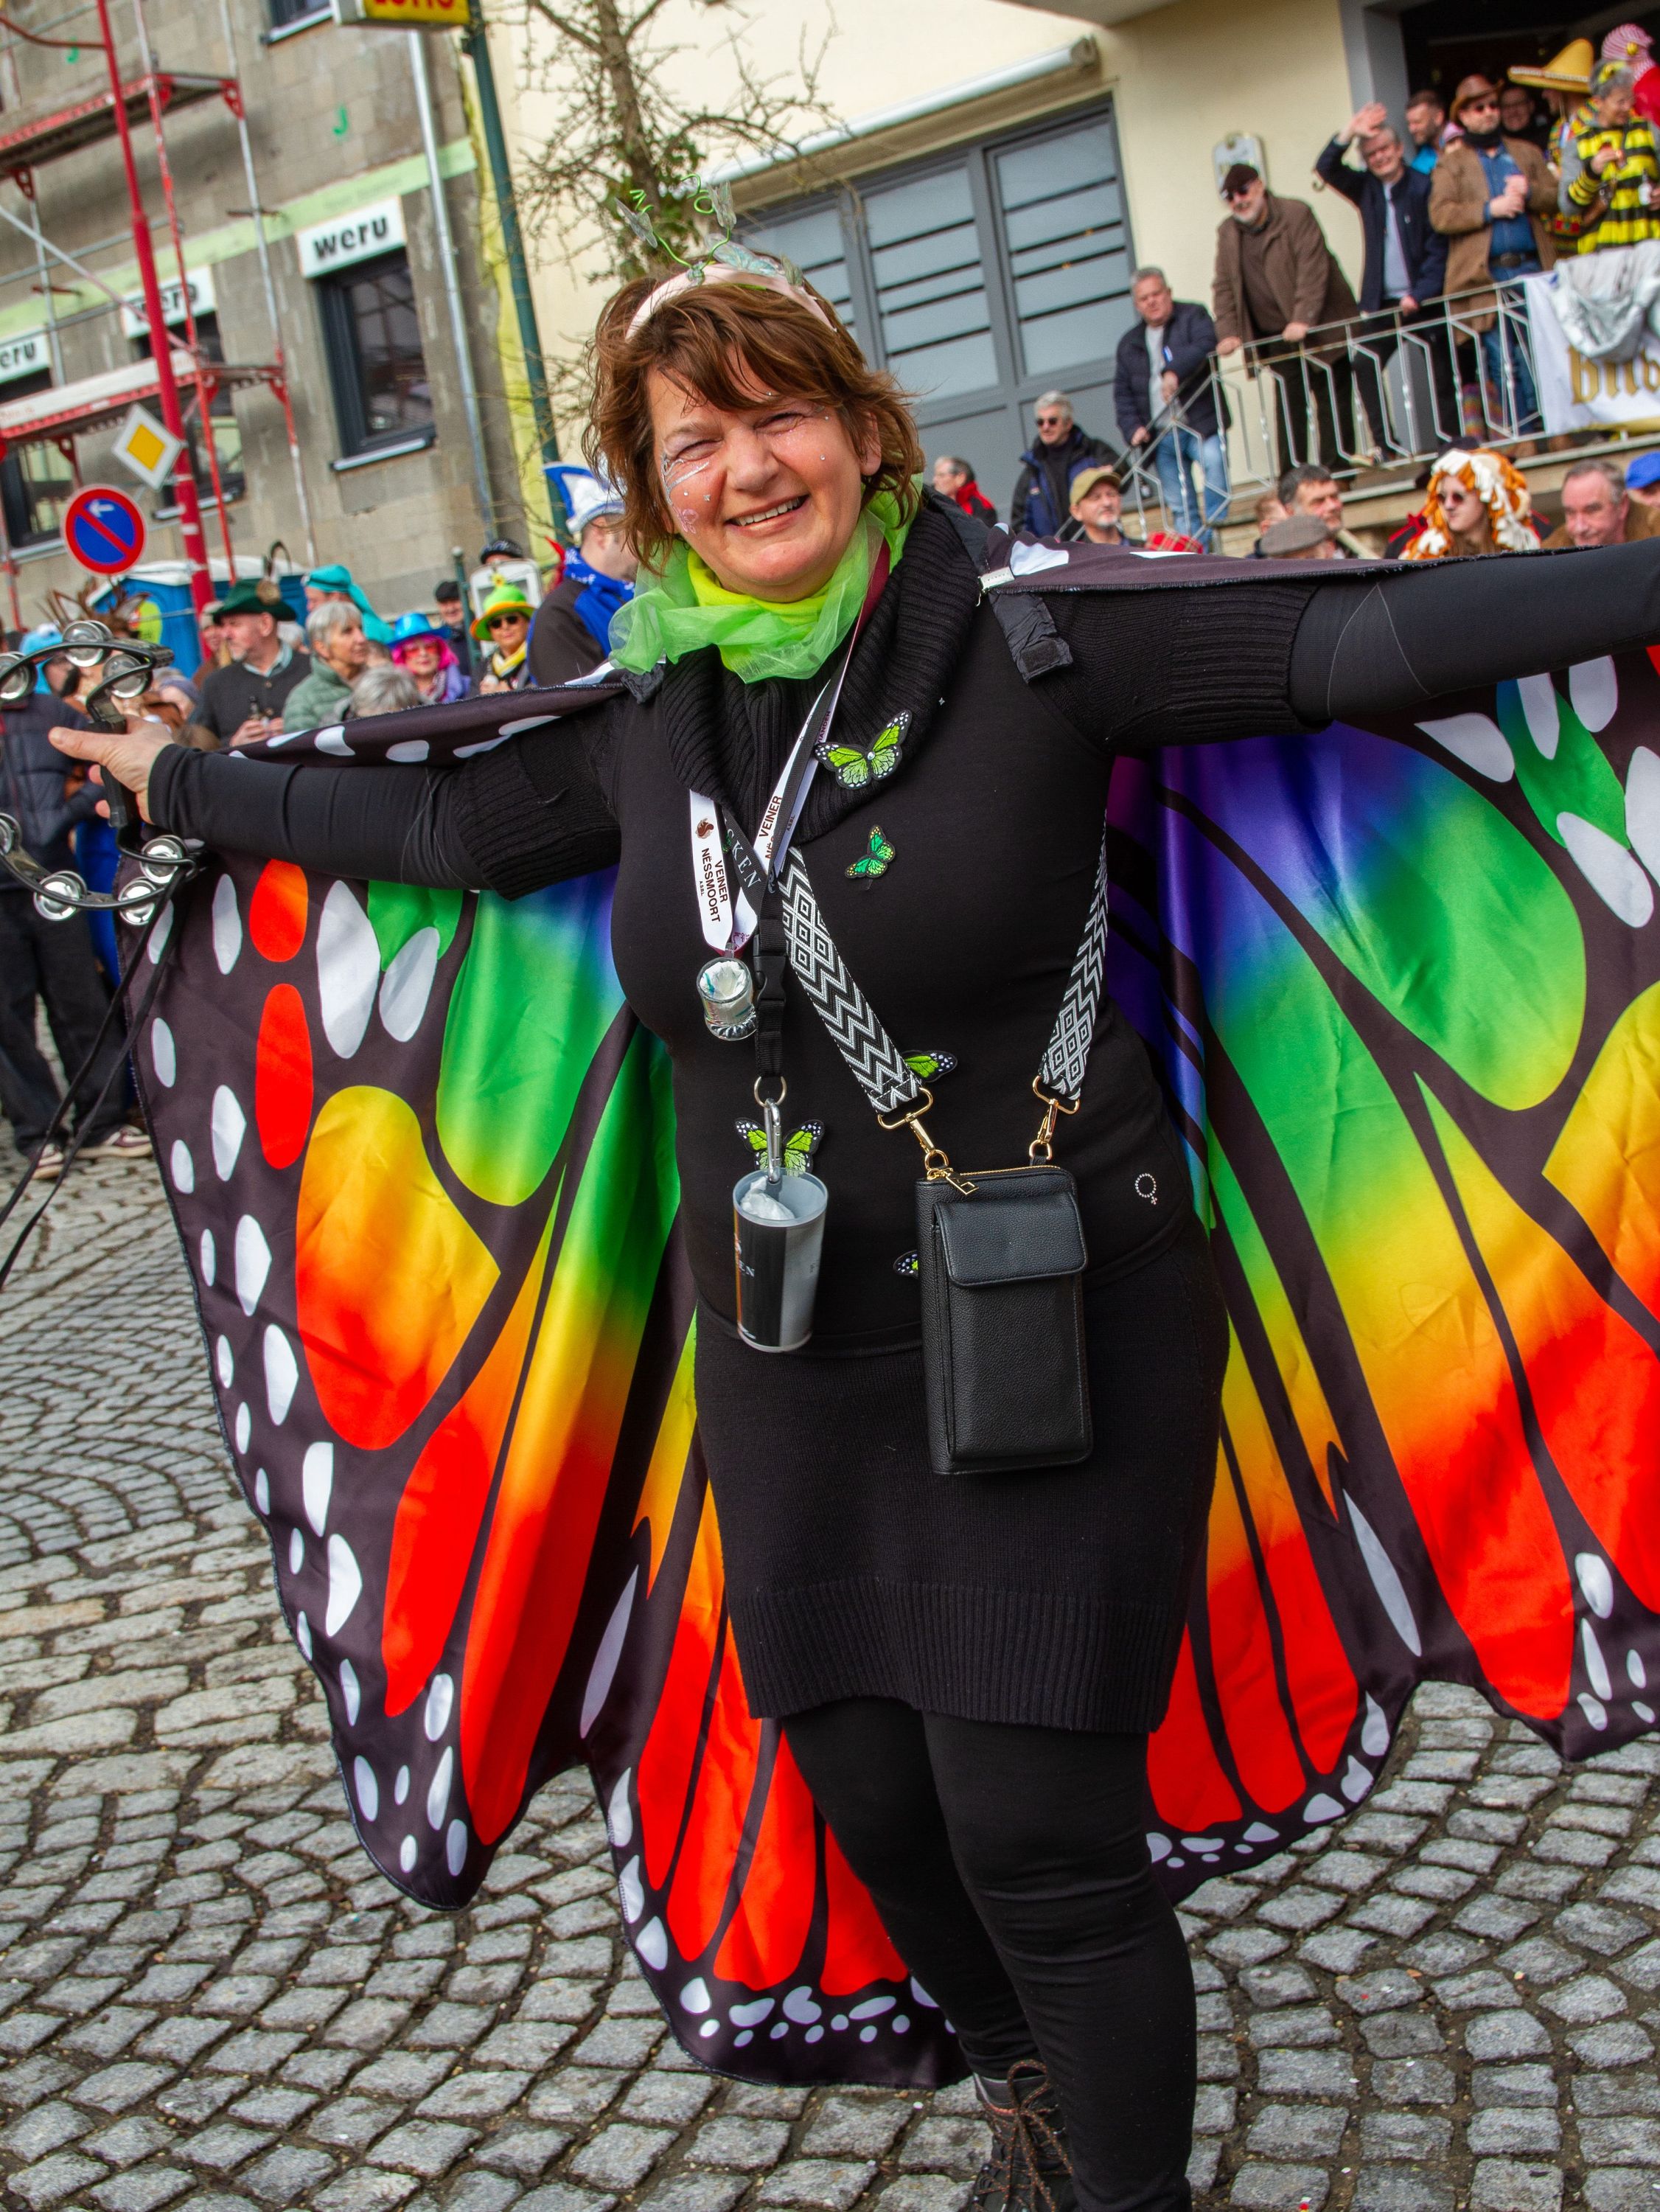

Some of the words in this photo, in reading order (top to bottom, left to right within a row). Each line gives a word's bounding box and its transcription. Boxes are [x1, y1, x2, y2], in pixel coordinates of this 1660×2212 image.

[314, 217, 388, 259] weru
[758, 796, 783, 838] VEINER
[725, 817, 761, 888] CKEN
[701, 847, 721, 922] NËSSMOORT
[714, 860, 728, 903] VEINER
